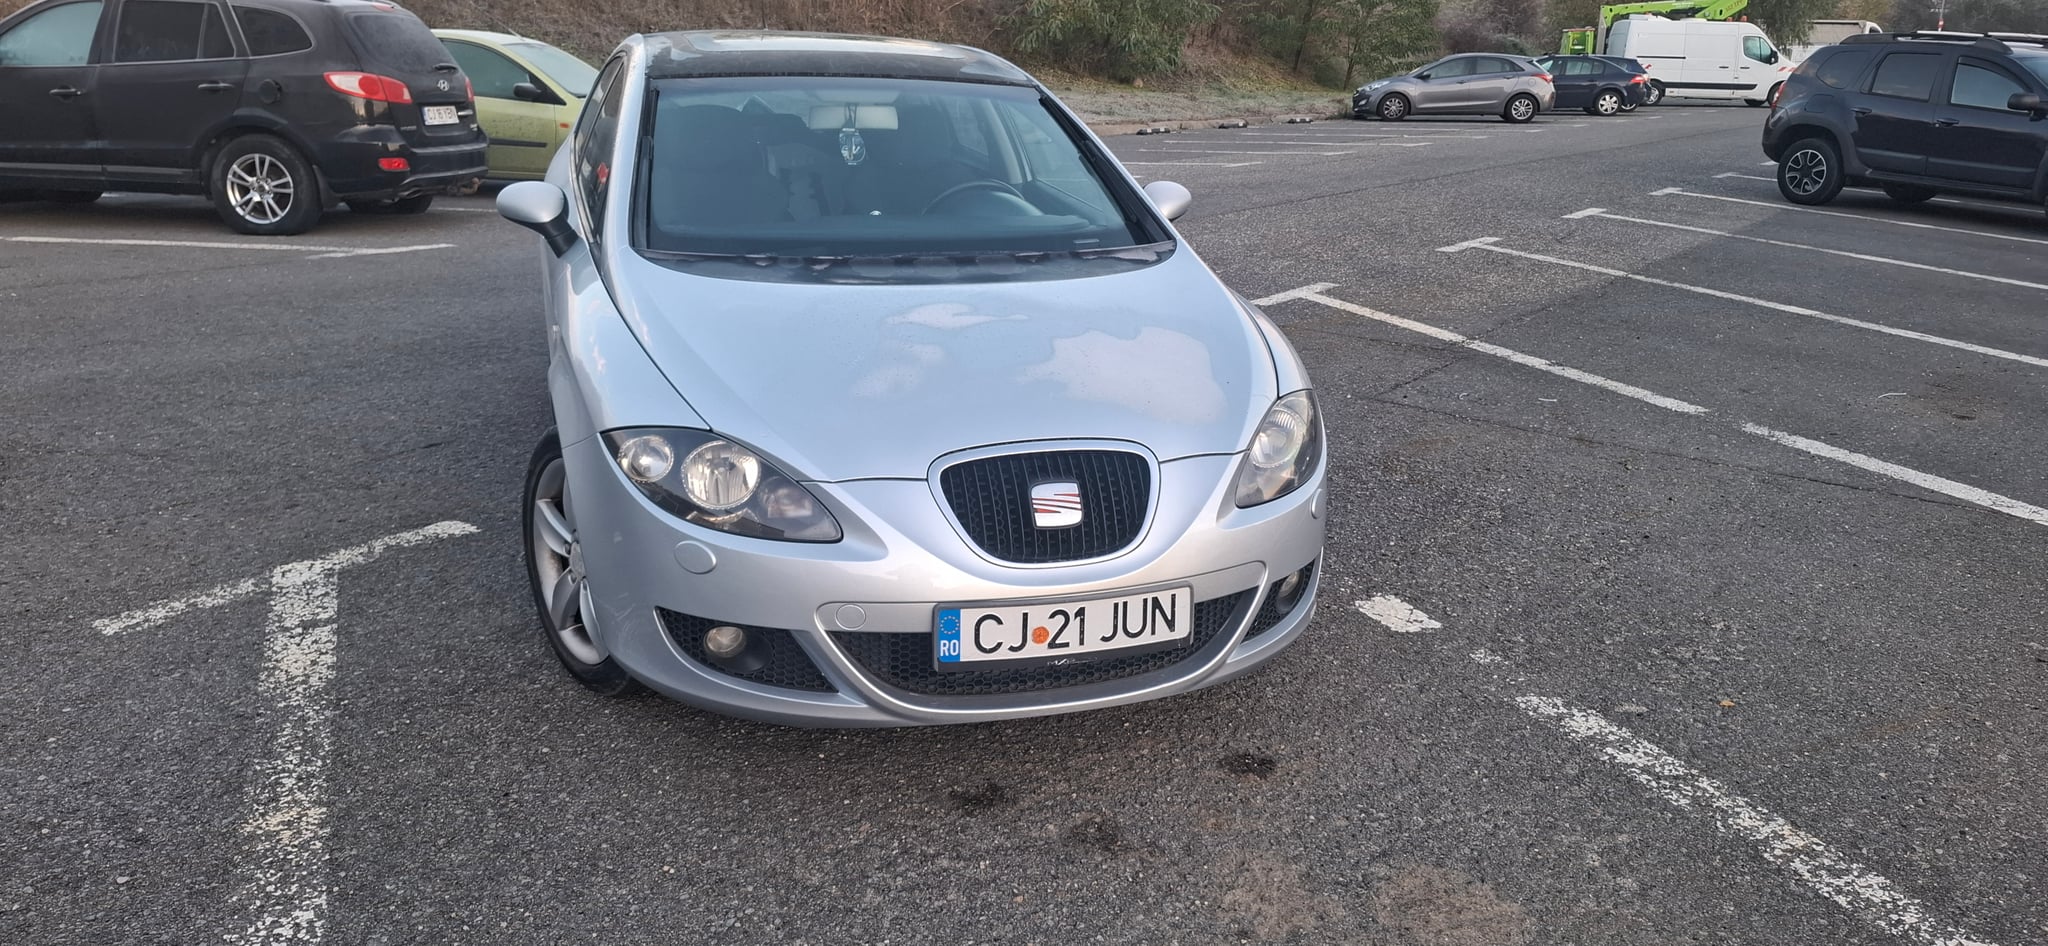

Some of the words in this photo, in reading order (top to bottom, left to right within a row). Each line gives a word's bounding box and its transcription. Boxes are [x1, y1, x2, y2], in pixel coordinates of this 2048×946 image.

[427, 108, 436, 121] CJ
[974, 612, 1028, 654] CJ
[1048, 607, 1086, 650] 21
[1100, 593, 1177, 642] JUN
[940, 639, 959, 657] RO
